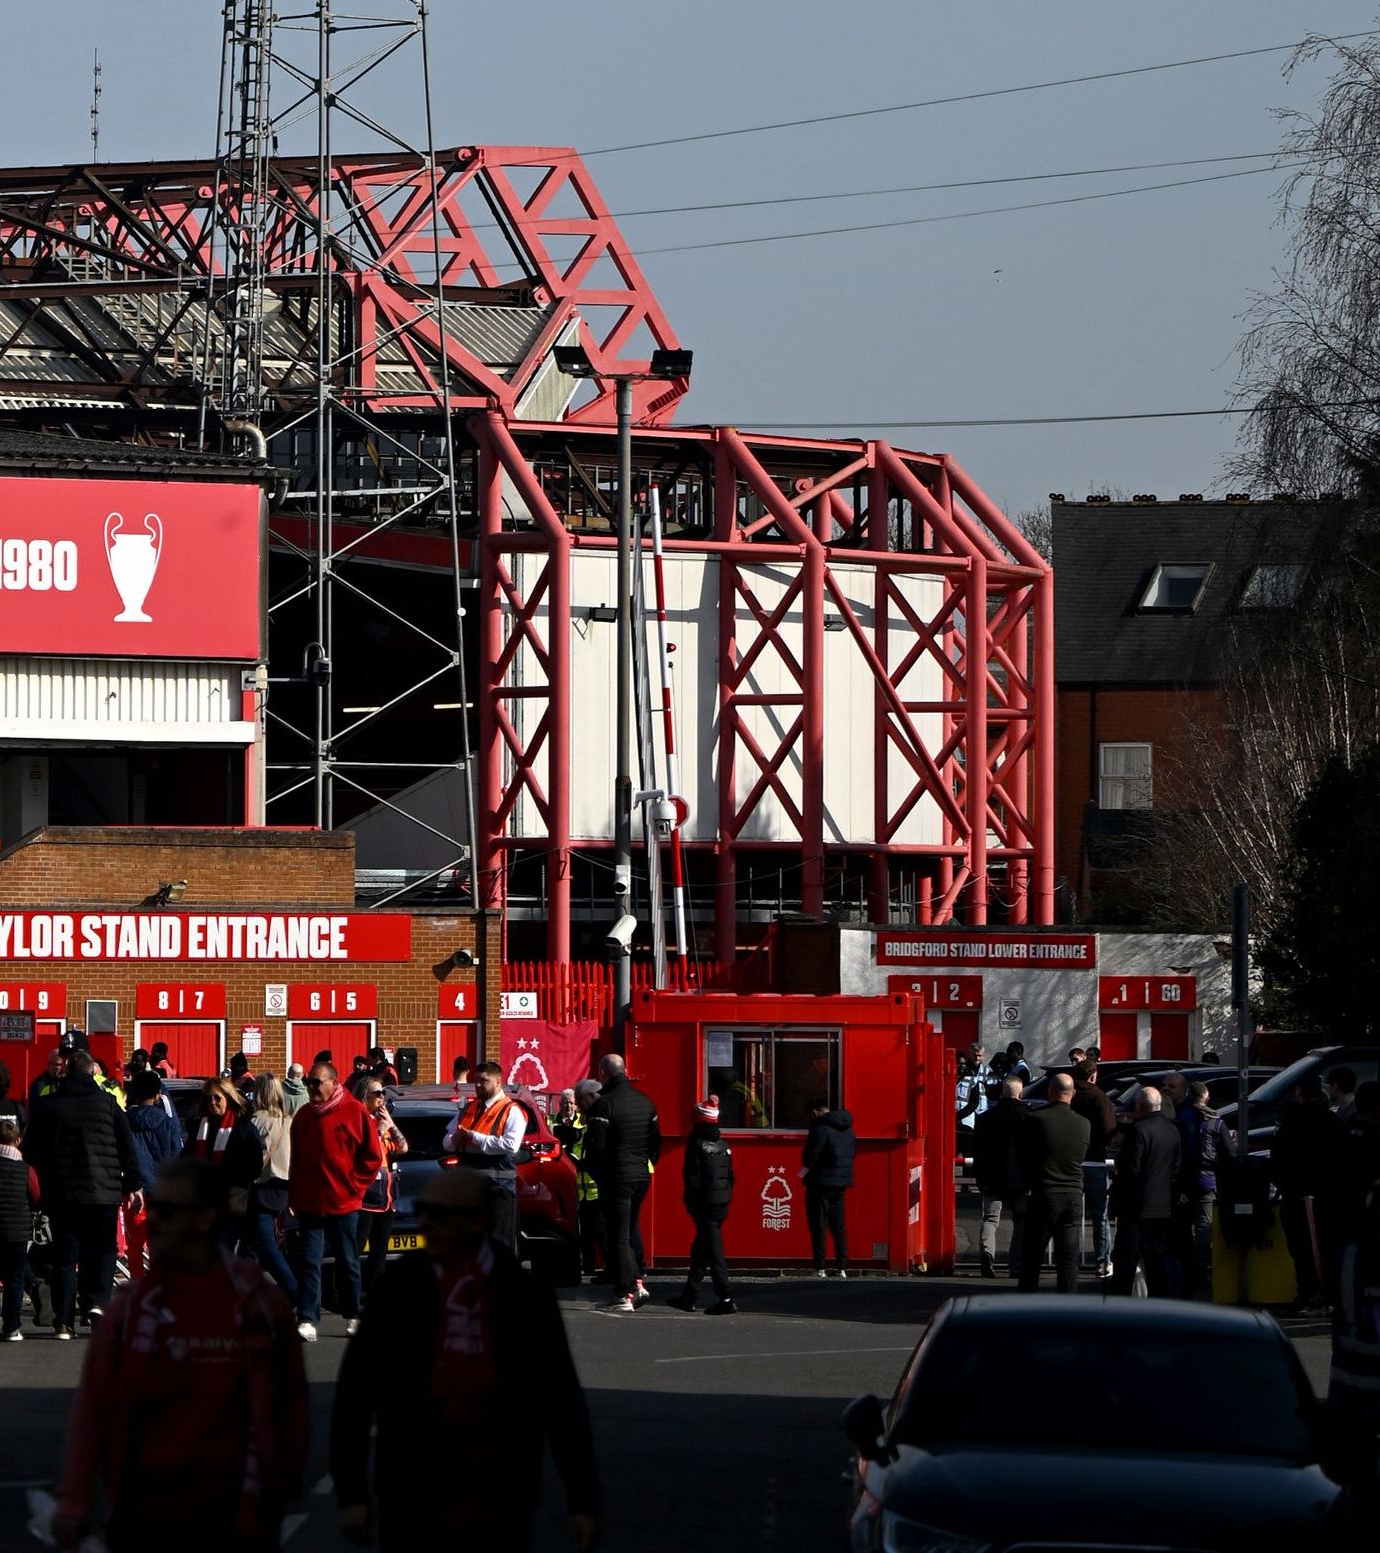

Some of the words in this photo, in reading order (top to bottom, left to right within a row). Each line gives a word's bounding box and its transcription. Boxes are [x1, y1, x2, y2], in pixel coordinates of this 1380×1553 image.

[80, 915, 182, 959] STAND
[187, 916, 349, 960] ENTRANCE
[885, 941, 948, 957] BRIDGFORD
[950, 942, 987, 958] STAND
[988, 943, 1028, 959] LOWER
[1029, 944, 1088, 959] ENTRANCE
[38, 991, 49, 1010] 9
[158, 990, 169, 1010] 8
[194, 991, 204, 1010] 7
[310, 992, 321, 1011] 6
[346, 991, 357, 1011] 5
[454, 992, 465, 1011] 4
[949, 983, 960, 1001] 2
[1120, 984, 1127, 1002] 1
[1161, 983, 1181, 1002] 60
[393, 1235, 418, 1249] BVB
